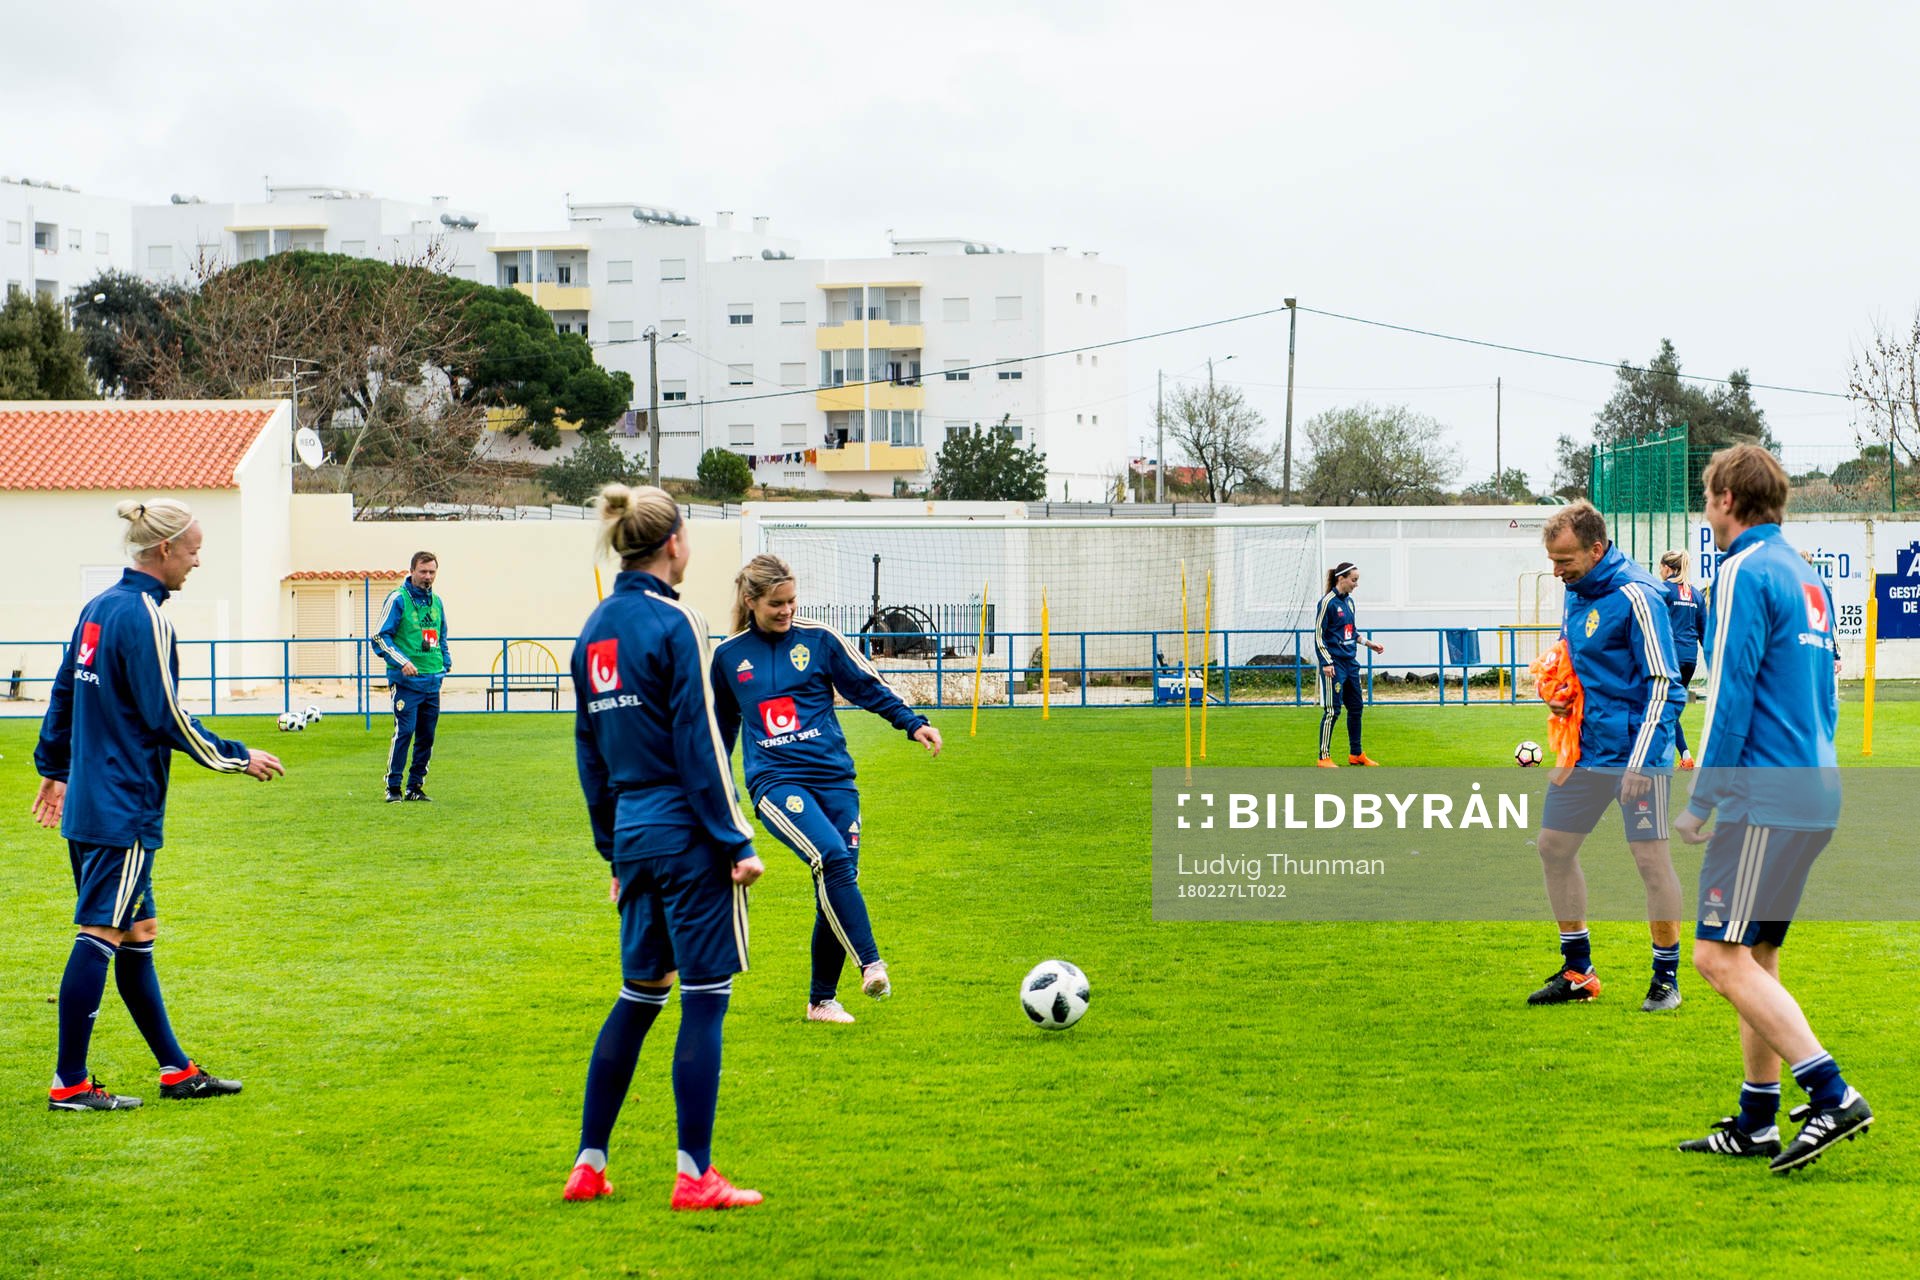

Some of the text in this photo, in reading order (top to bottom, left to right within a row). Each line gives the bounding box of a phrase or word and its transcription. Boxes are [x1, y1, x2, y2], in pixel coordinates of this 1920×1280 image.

[1841, 605, 1863, 615] 125
[1903, 601, 1918, 614] DE
[1840, 616, 1863, 626] 210
[1838, 627, 1862, 635] po.pt
[797, 727, 822, 740] SPEL
